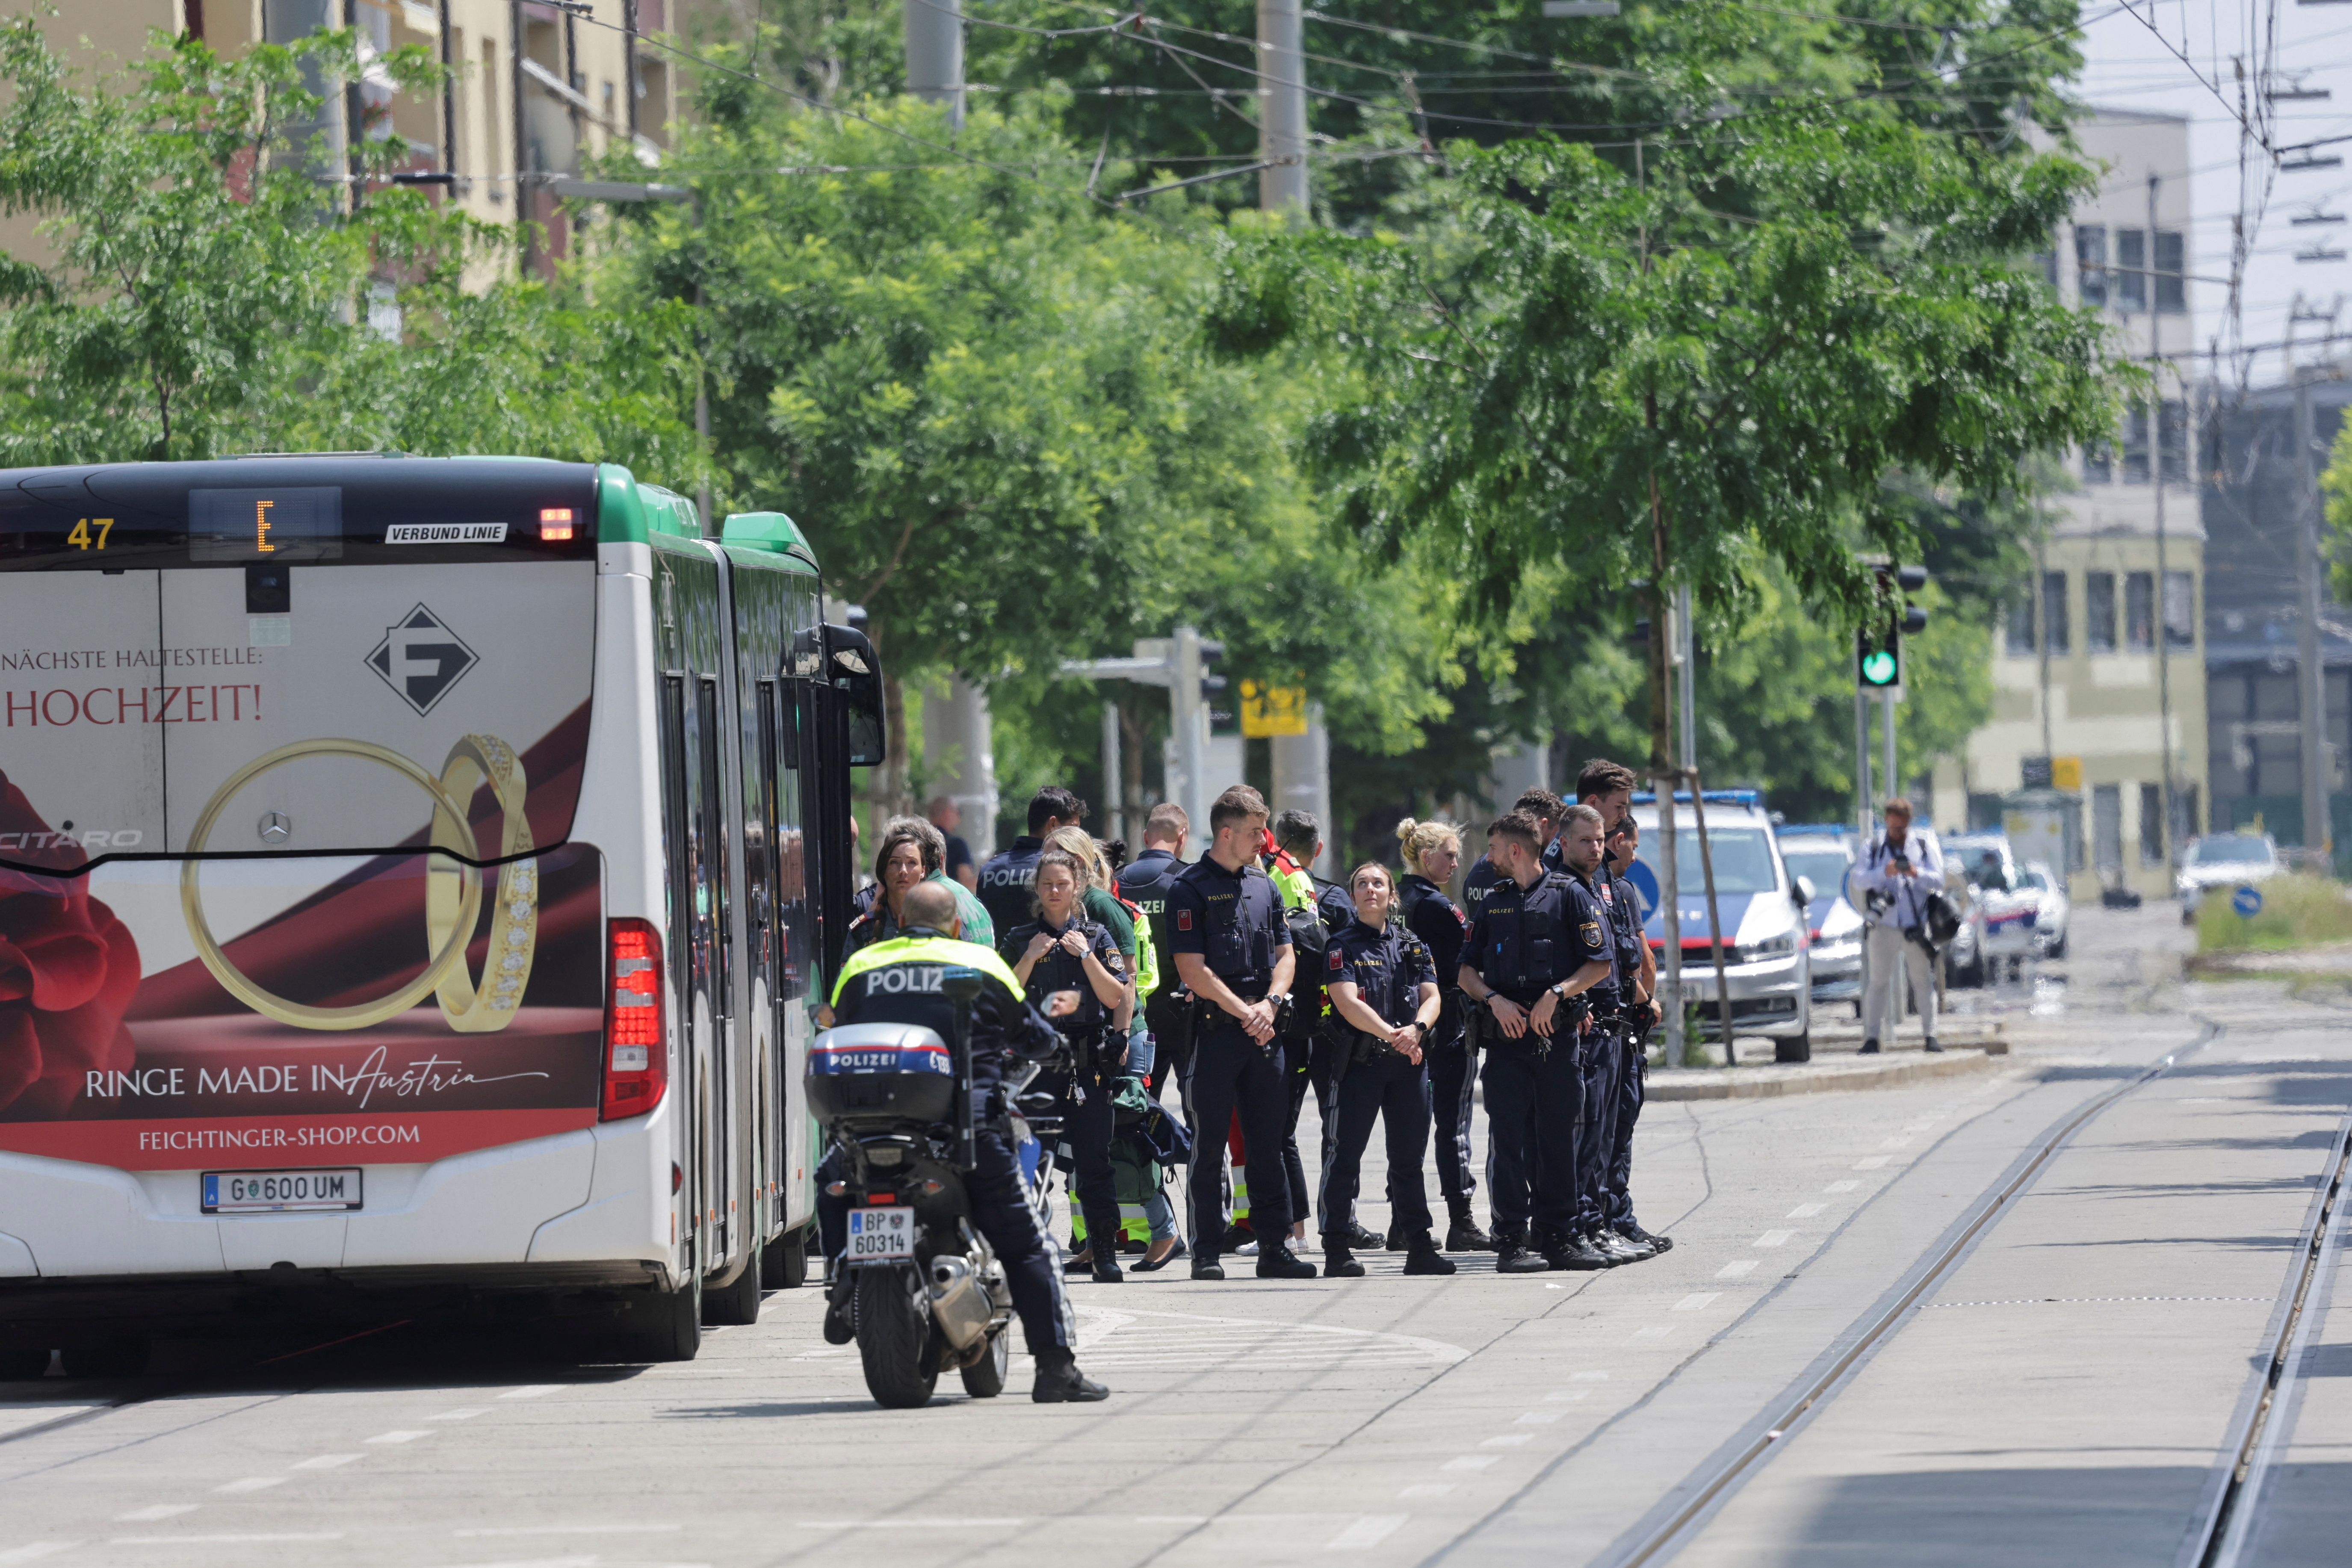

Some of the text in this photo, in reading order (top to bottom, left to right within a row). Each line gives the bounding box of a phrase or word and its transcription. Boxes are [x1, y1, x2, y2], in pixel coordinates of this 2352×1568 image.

[68, 518, 114, 550] 47
[257, 501, 274, 551] E
[393, 526, 501, 540] VERBUND LINIE
[2, 647, 263, 670] NÄCHSTE HALTESTELLE:
[6, 685, 261, 726] HOCHZEIT!
[0, 830, 143, 849] CITARO
[830, 1054, 896, 1066] POLIZEI
[87, 1045, 549, 1108] RINGE MADE IN Austria
[140, 1125, 420, 1150] FEICHTINGER-SHOP.COM
[231, 1176, 343, 1200] G 600 UM
[866, 1213, 886, 1231] BP
[856, 1234, 905, 1254] 60314
